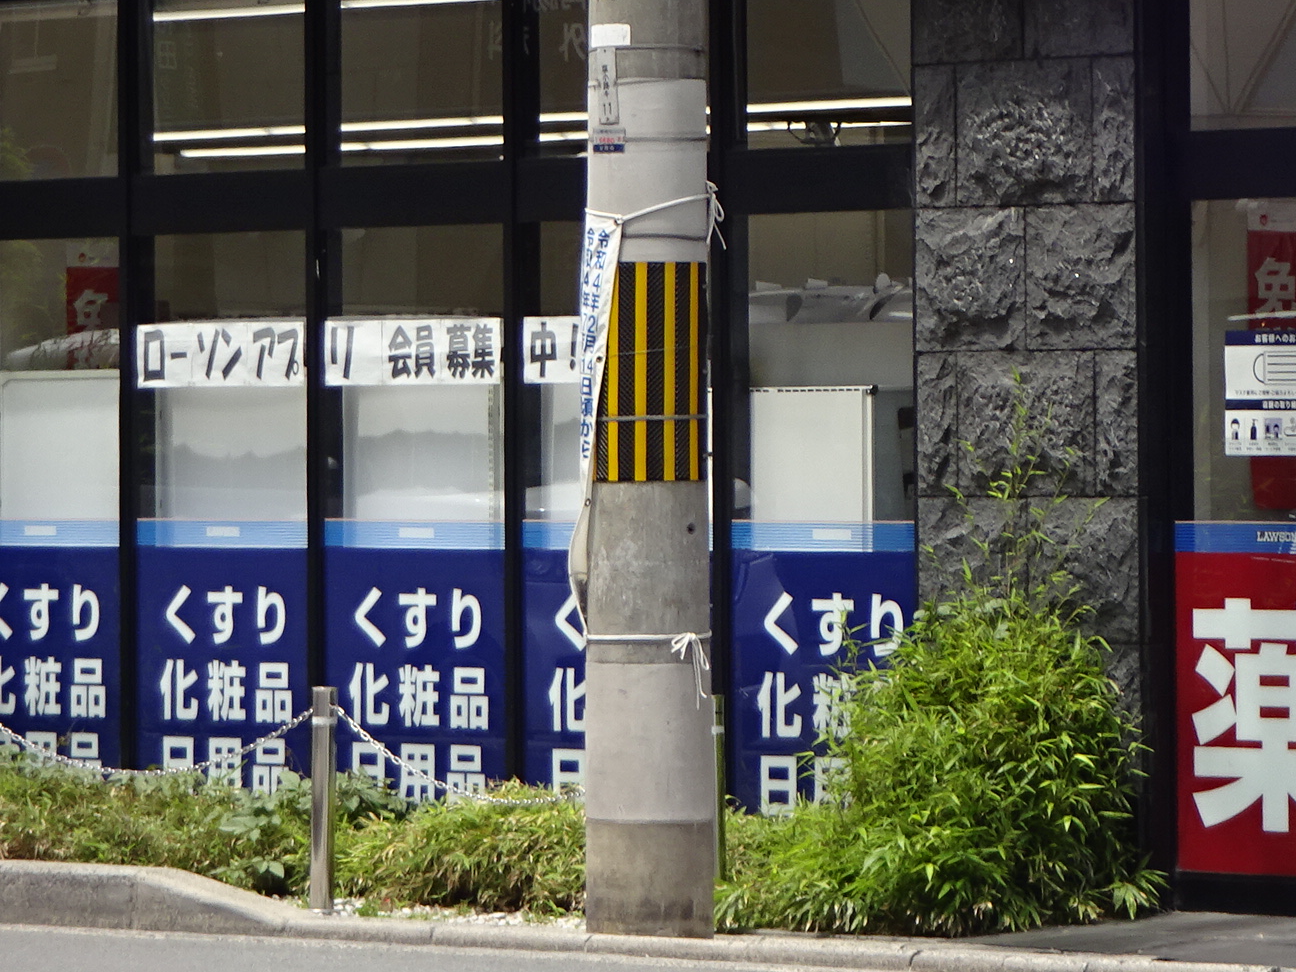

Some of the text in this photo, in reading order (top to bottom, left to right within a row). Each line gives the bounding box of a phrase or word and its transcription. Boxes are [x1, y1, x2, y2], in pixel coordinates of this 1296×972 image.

[165, 585, 287, 644] くすり
[354, 587, 482, 648] くすり
[764, 591, 904, 657] くすり
[160, 661, 293, 723] 化粧品
[348, 662, 489, 730] 化粧品
